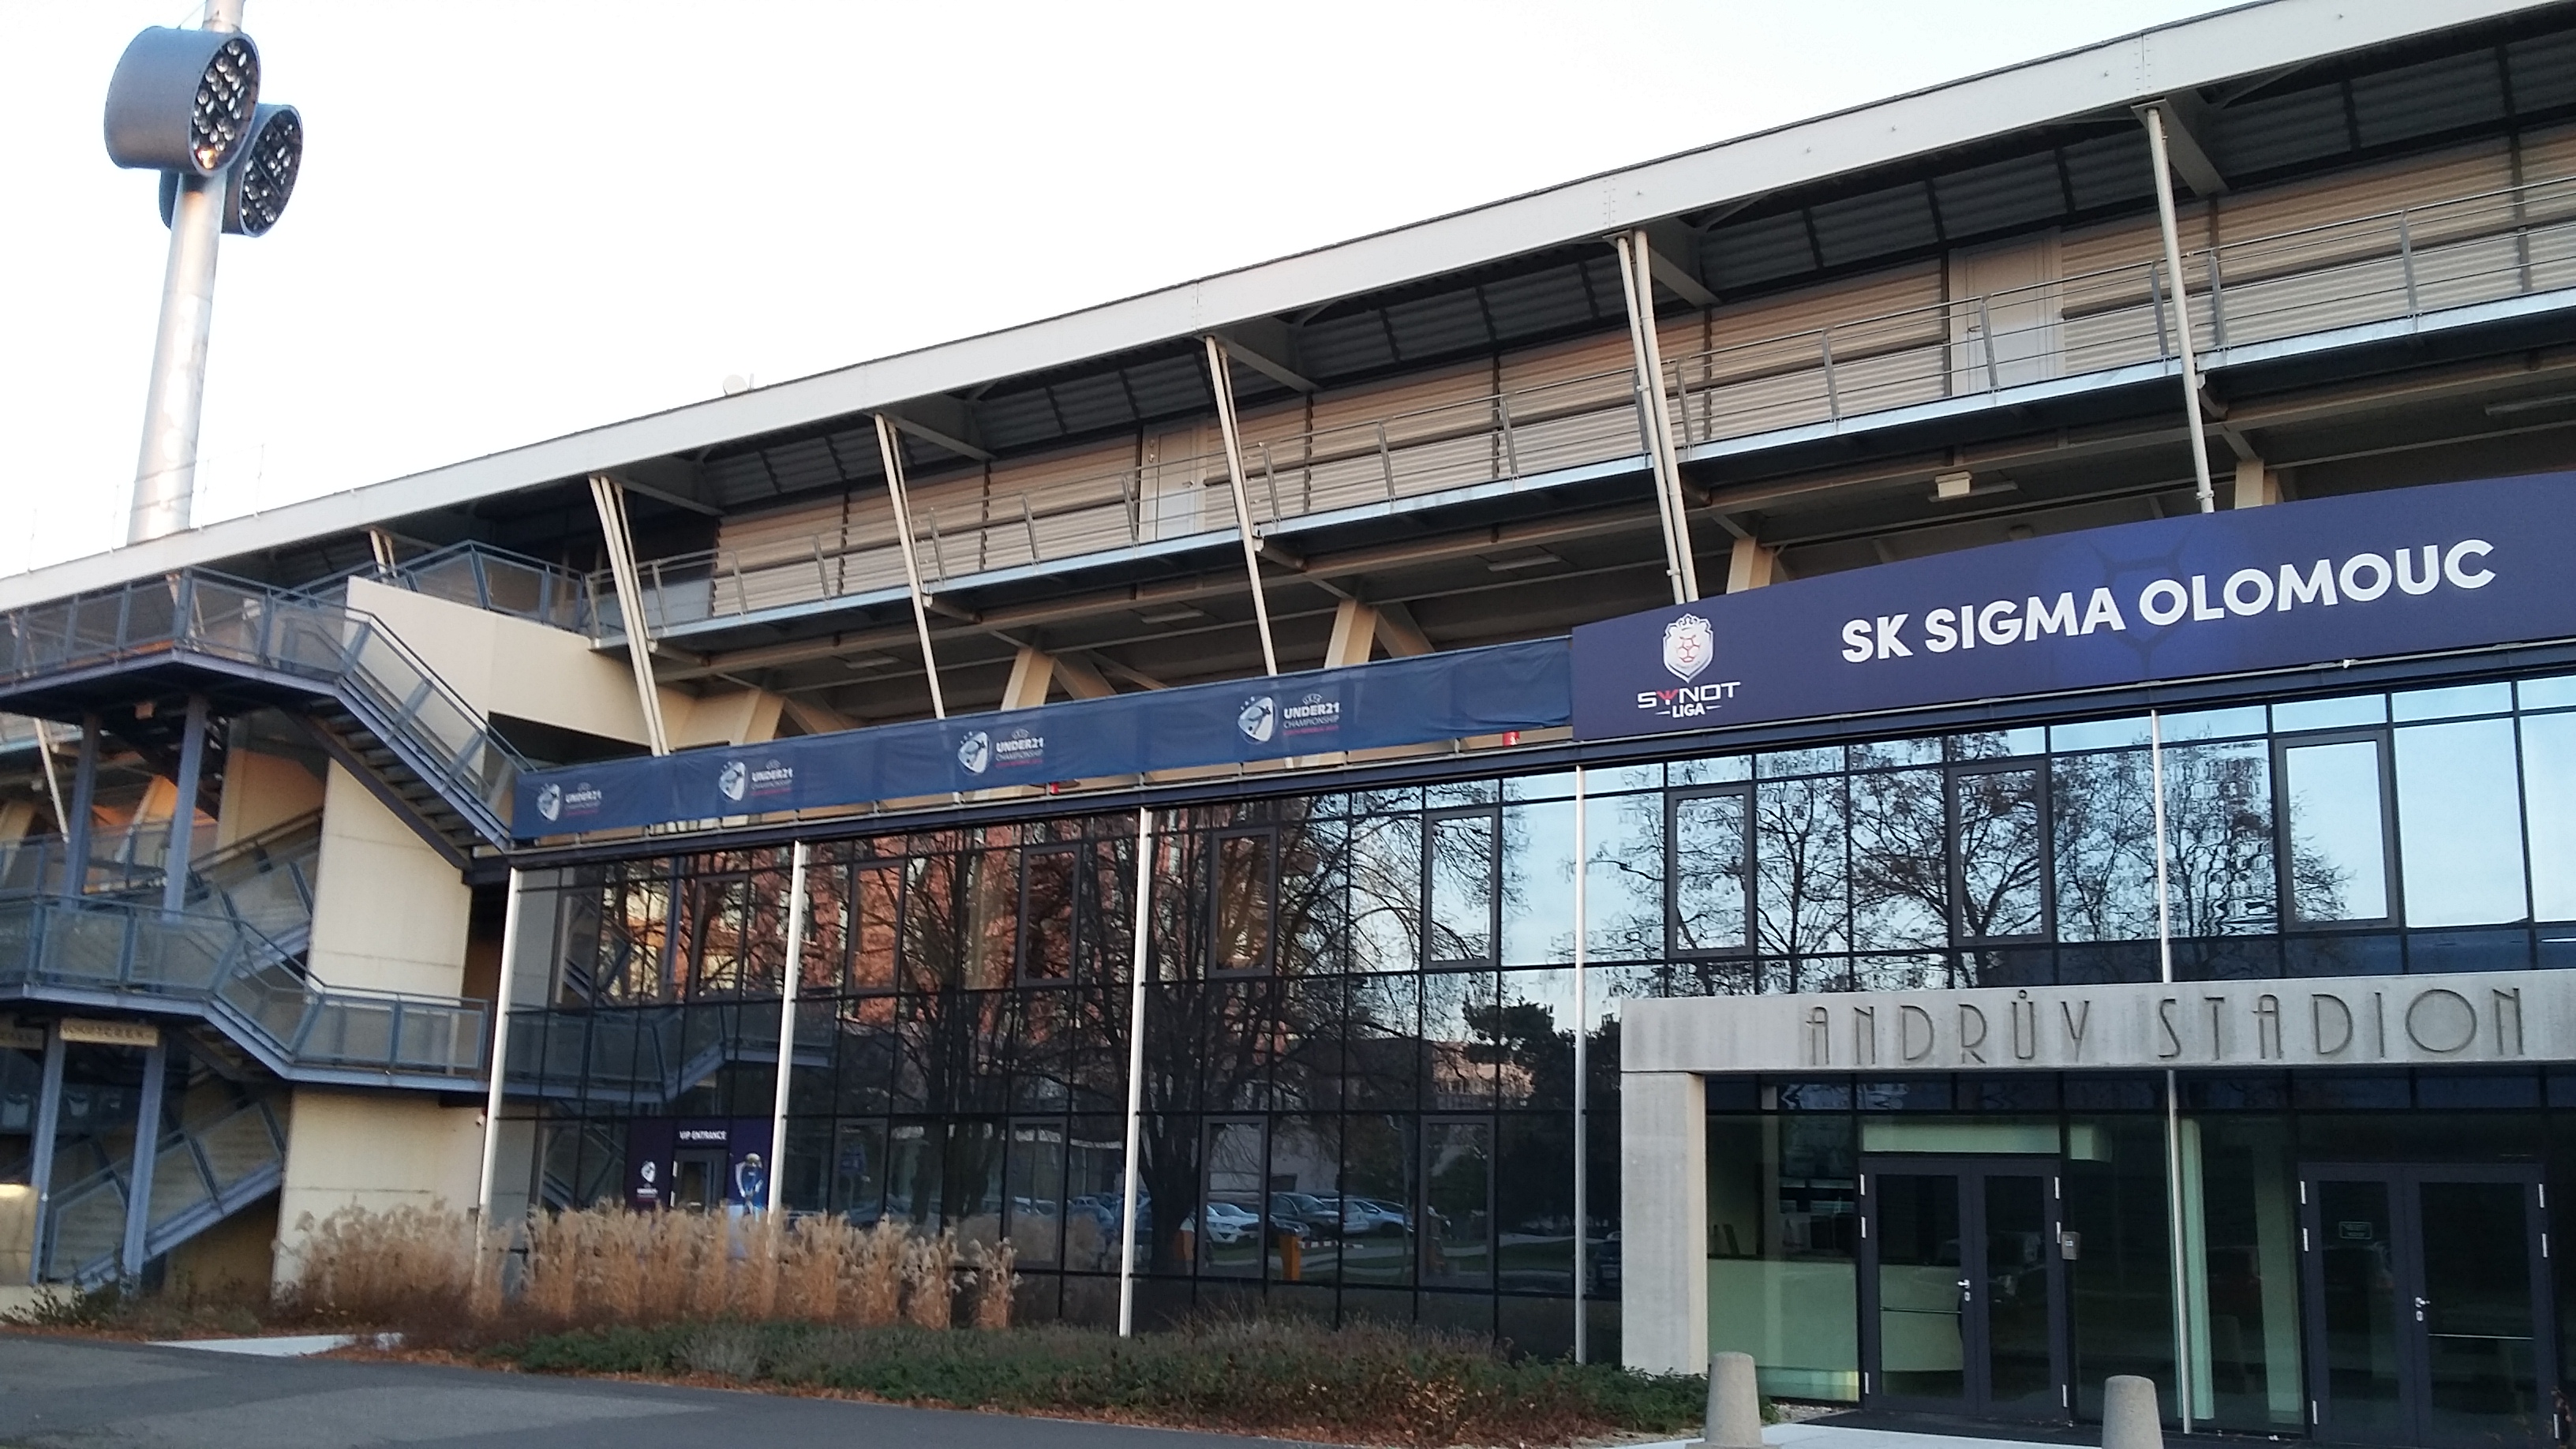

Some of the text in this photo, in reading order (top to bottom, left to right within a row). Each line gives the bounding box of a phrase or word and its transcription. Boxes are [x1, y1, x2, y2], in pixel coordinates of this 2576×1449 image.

[1841, 539, 2496, 663] SK SIGMA OLOMOUC
[1637, 681, 1742, 709] SYNOT
[1283, 702, 1340, 719] UNDER21
[1672, 702, 1706, 718] LIGA
[996, 737, 1044, 753] UNDER21
[751, 767, 793, 782] UNDER21
[1805, 987, 2525, 1065] ANDRŮV STADION
[679, 1130, 727, 1140] VIP ENTRANCE
